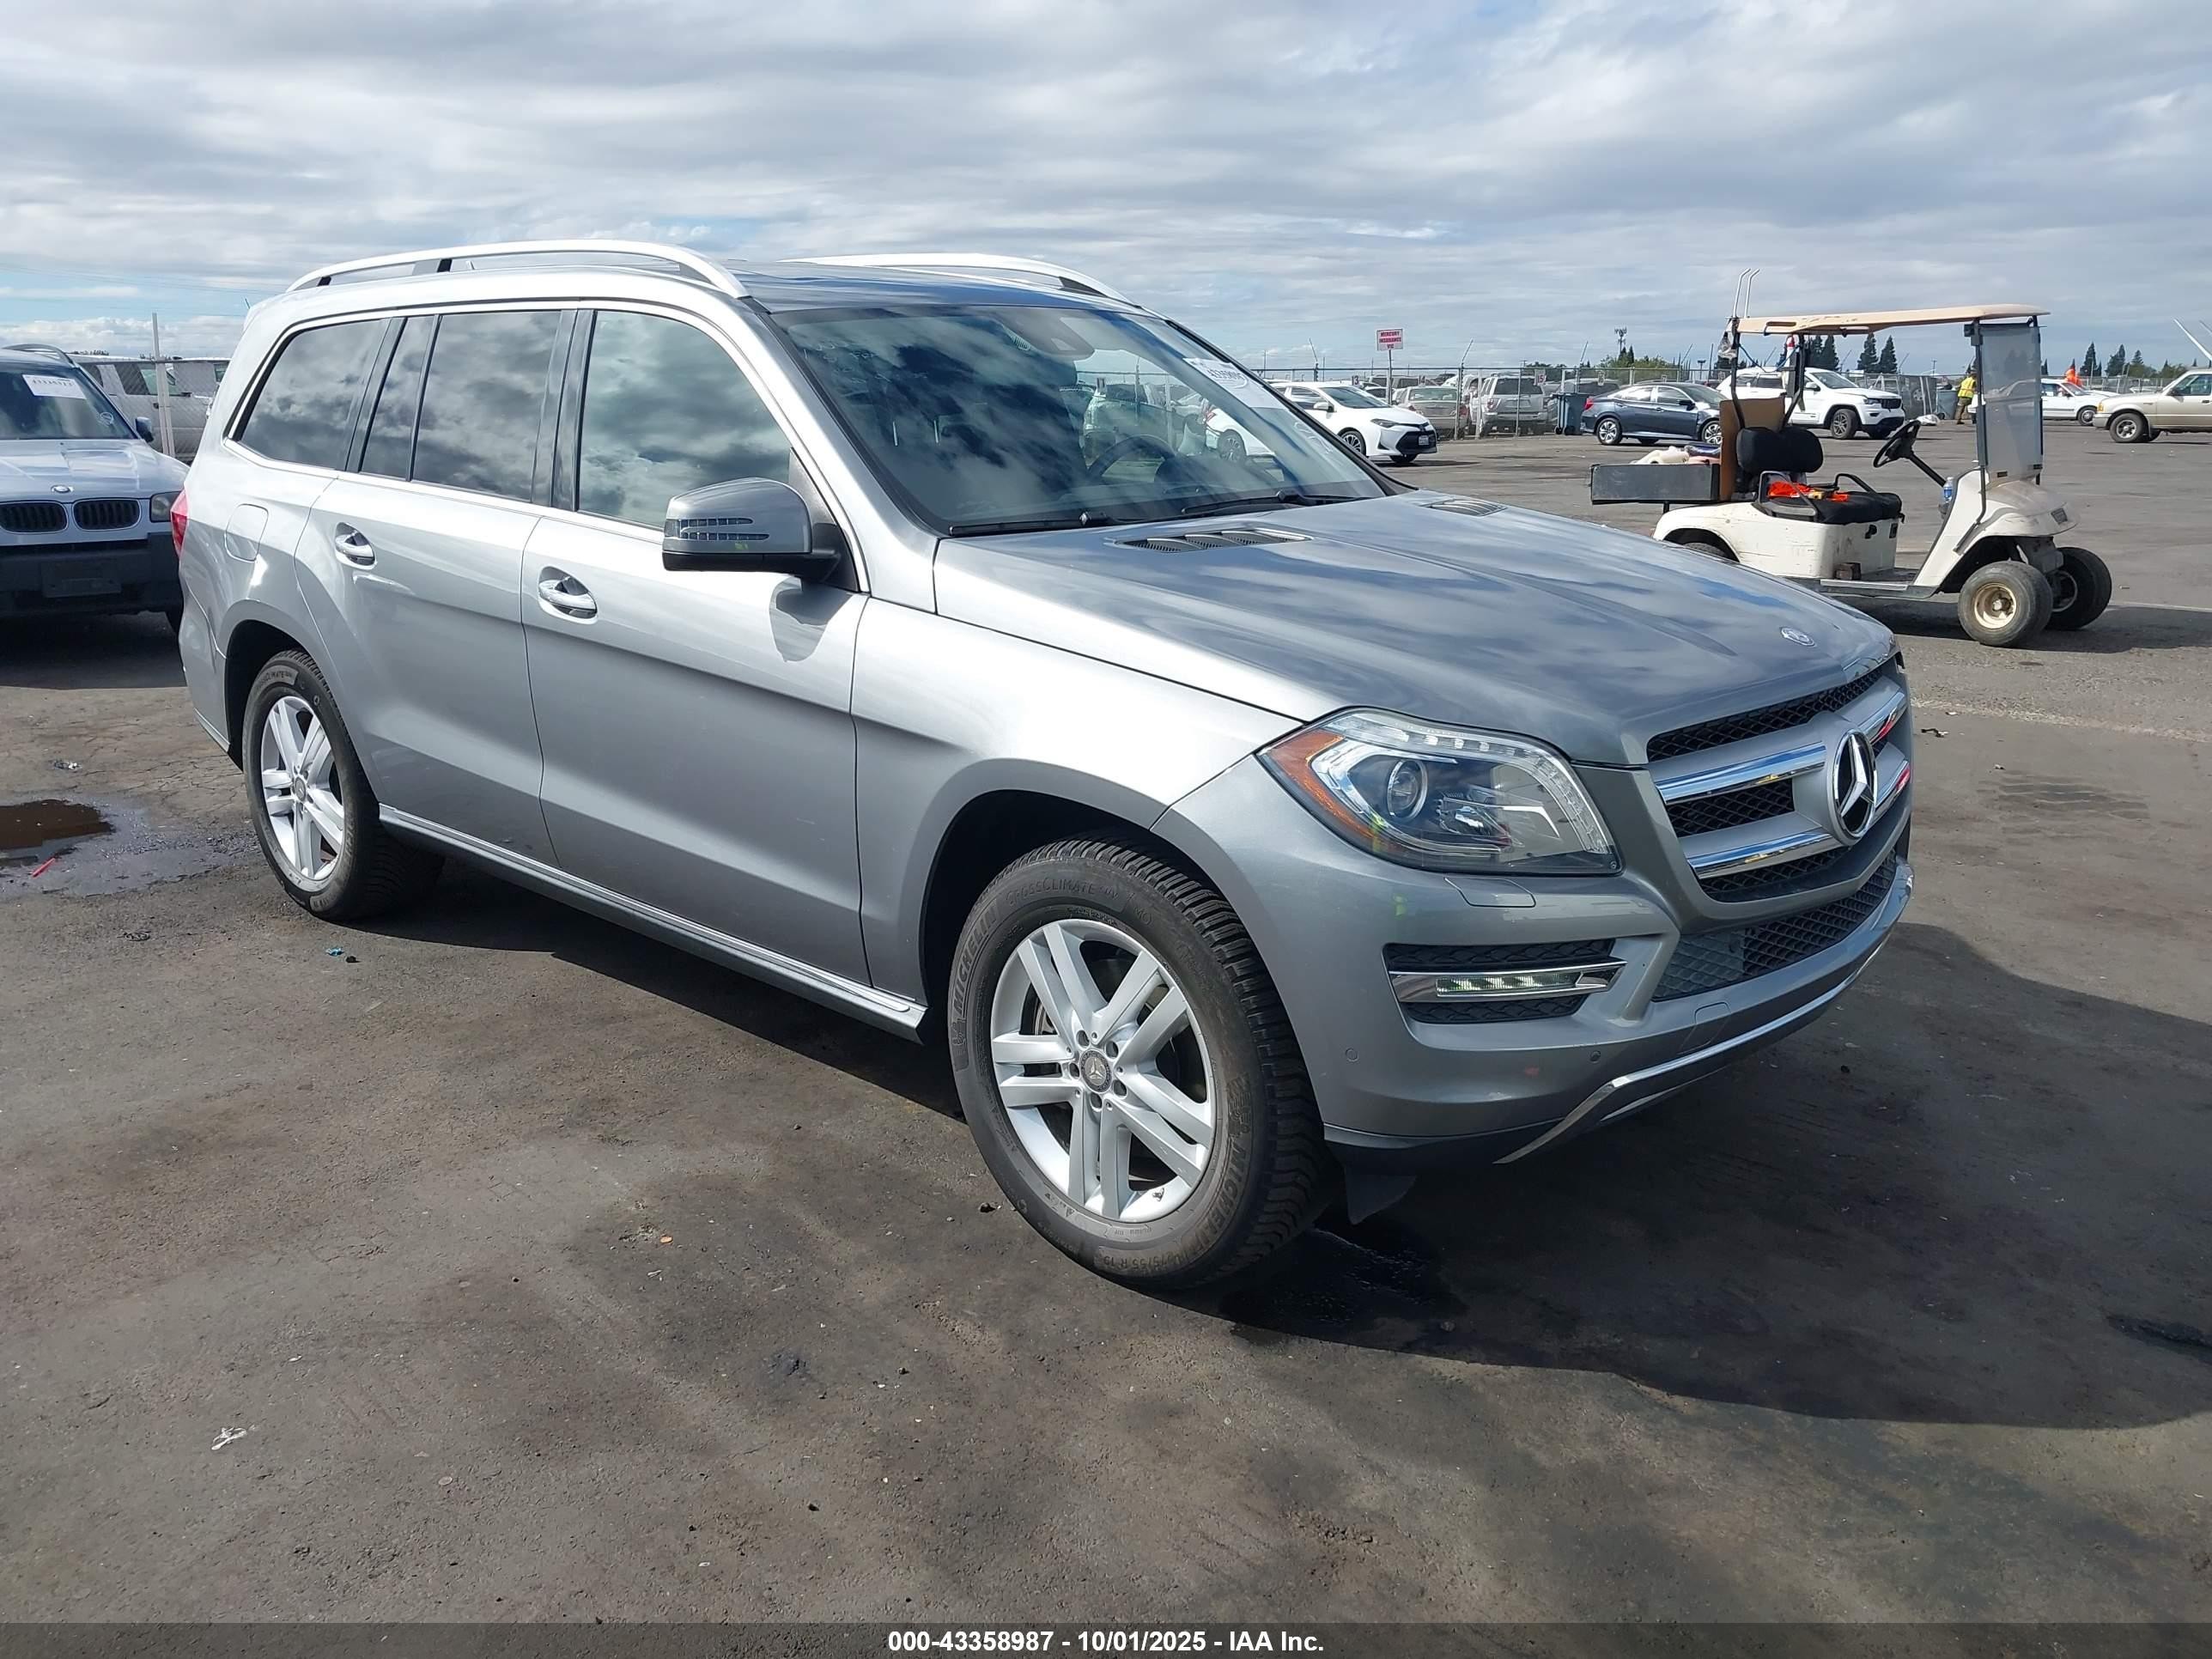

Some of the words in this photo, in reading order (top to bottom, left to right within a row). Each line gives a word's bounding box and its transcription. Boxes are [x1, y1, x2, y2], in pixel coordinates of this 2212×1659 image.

[1352, 375, 1359, 386] 13
[1419, 375, 1425, 385] 14
[1538, 374, 1544, 383] 15
